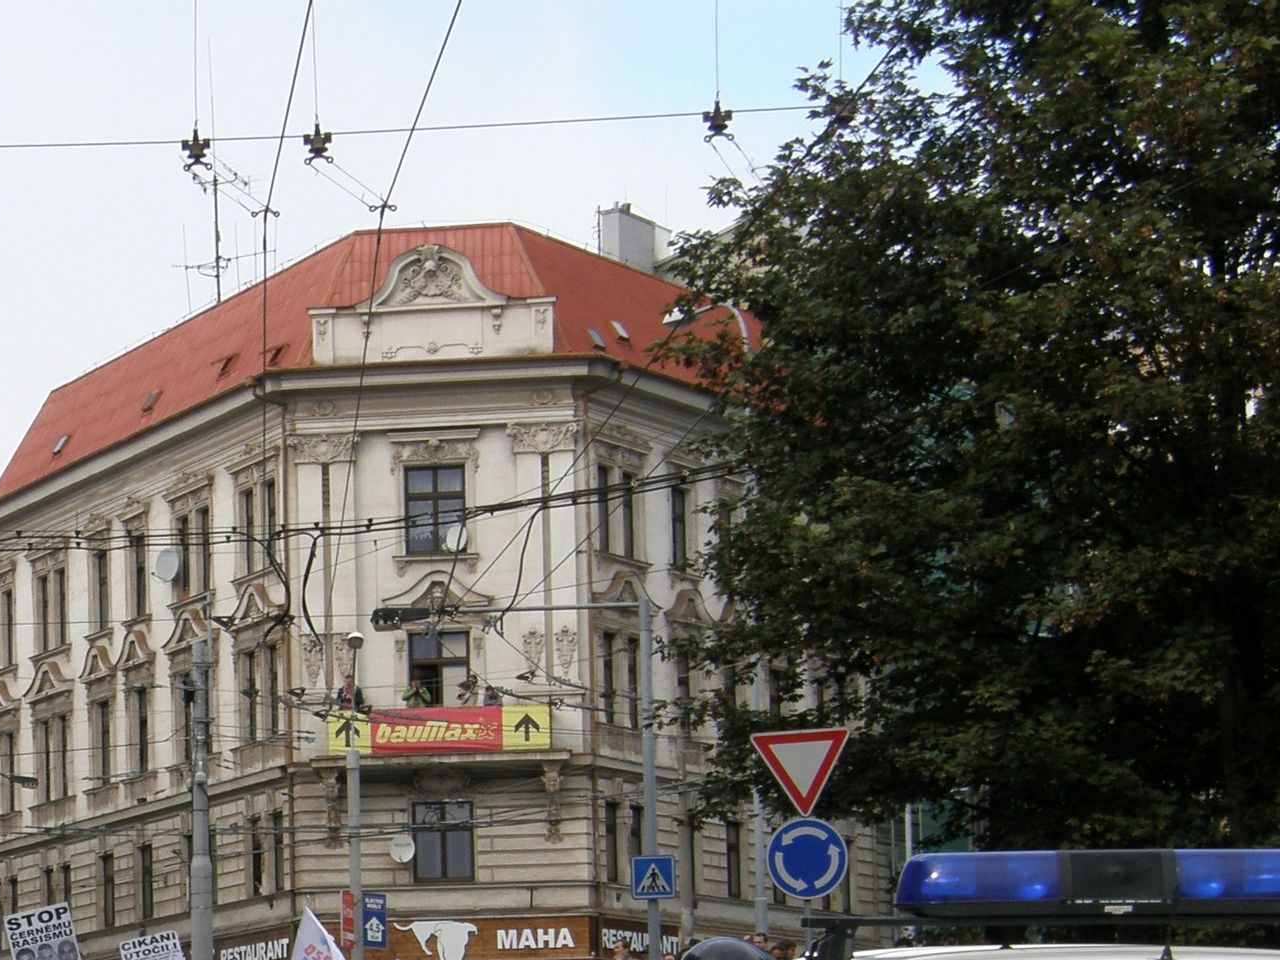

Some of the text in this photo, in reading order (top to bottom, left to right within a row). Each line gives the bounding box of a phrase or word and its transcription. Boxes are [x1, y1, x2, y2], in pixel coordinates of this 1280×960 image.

[6, 906, 68, 931] STOP
[9, 921, 72, 941] ČERNÉMU
[11, 928, 73, 949] RASISMU
[121, 932, 176, 951] CIKÁNI
[496, 927, 576, 950] MAHA
[601, 928, 679, 955] RESTAUNT
